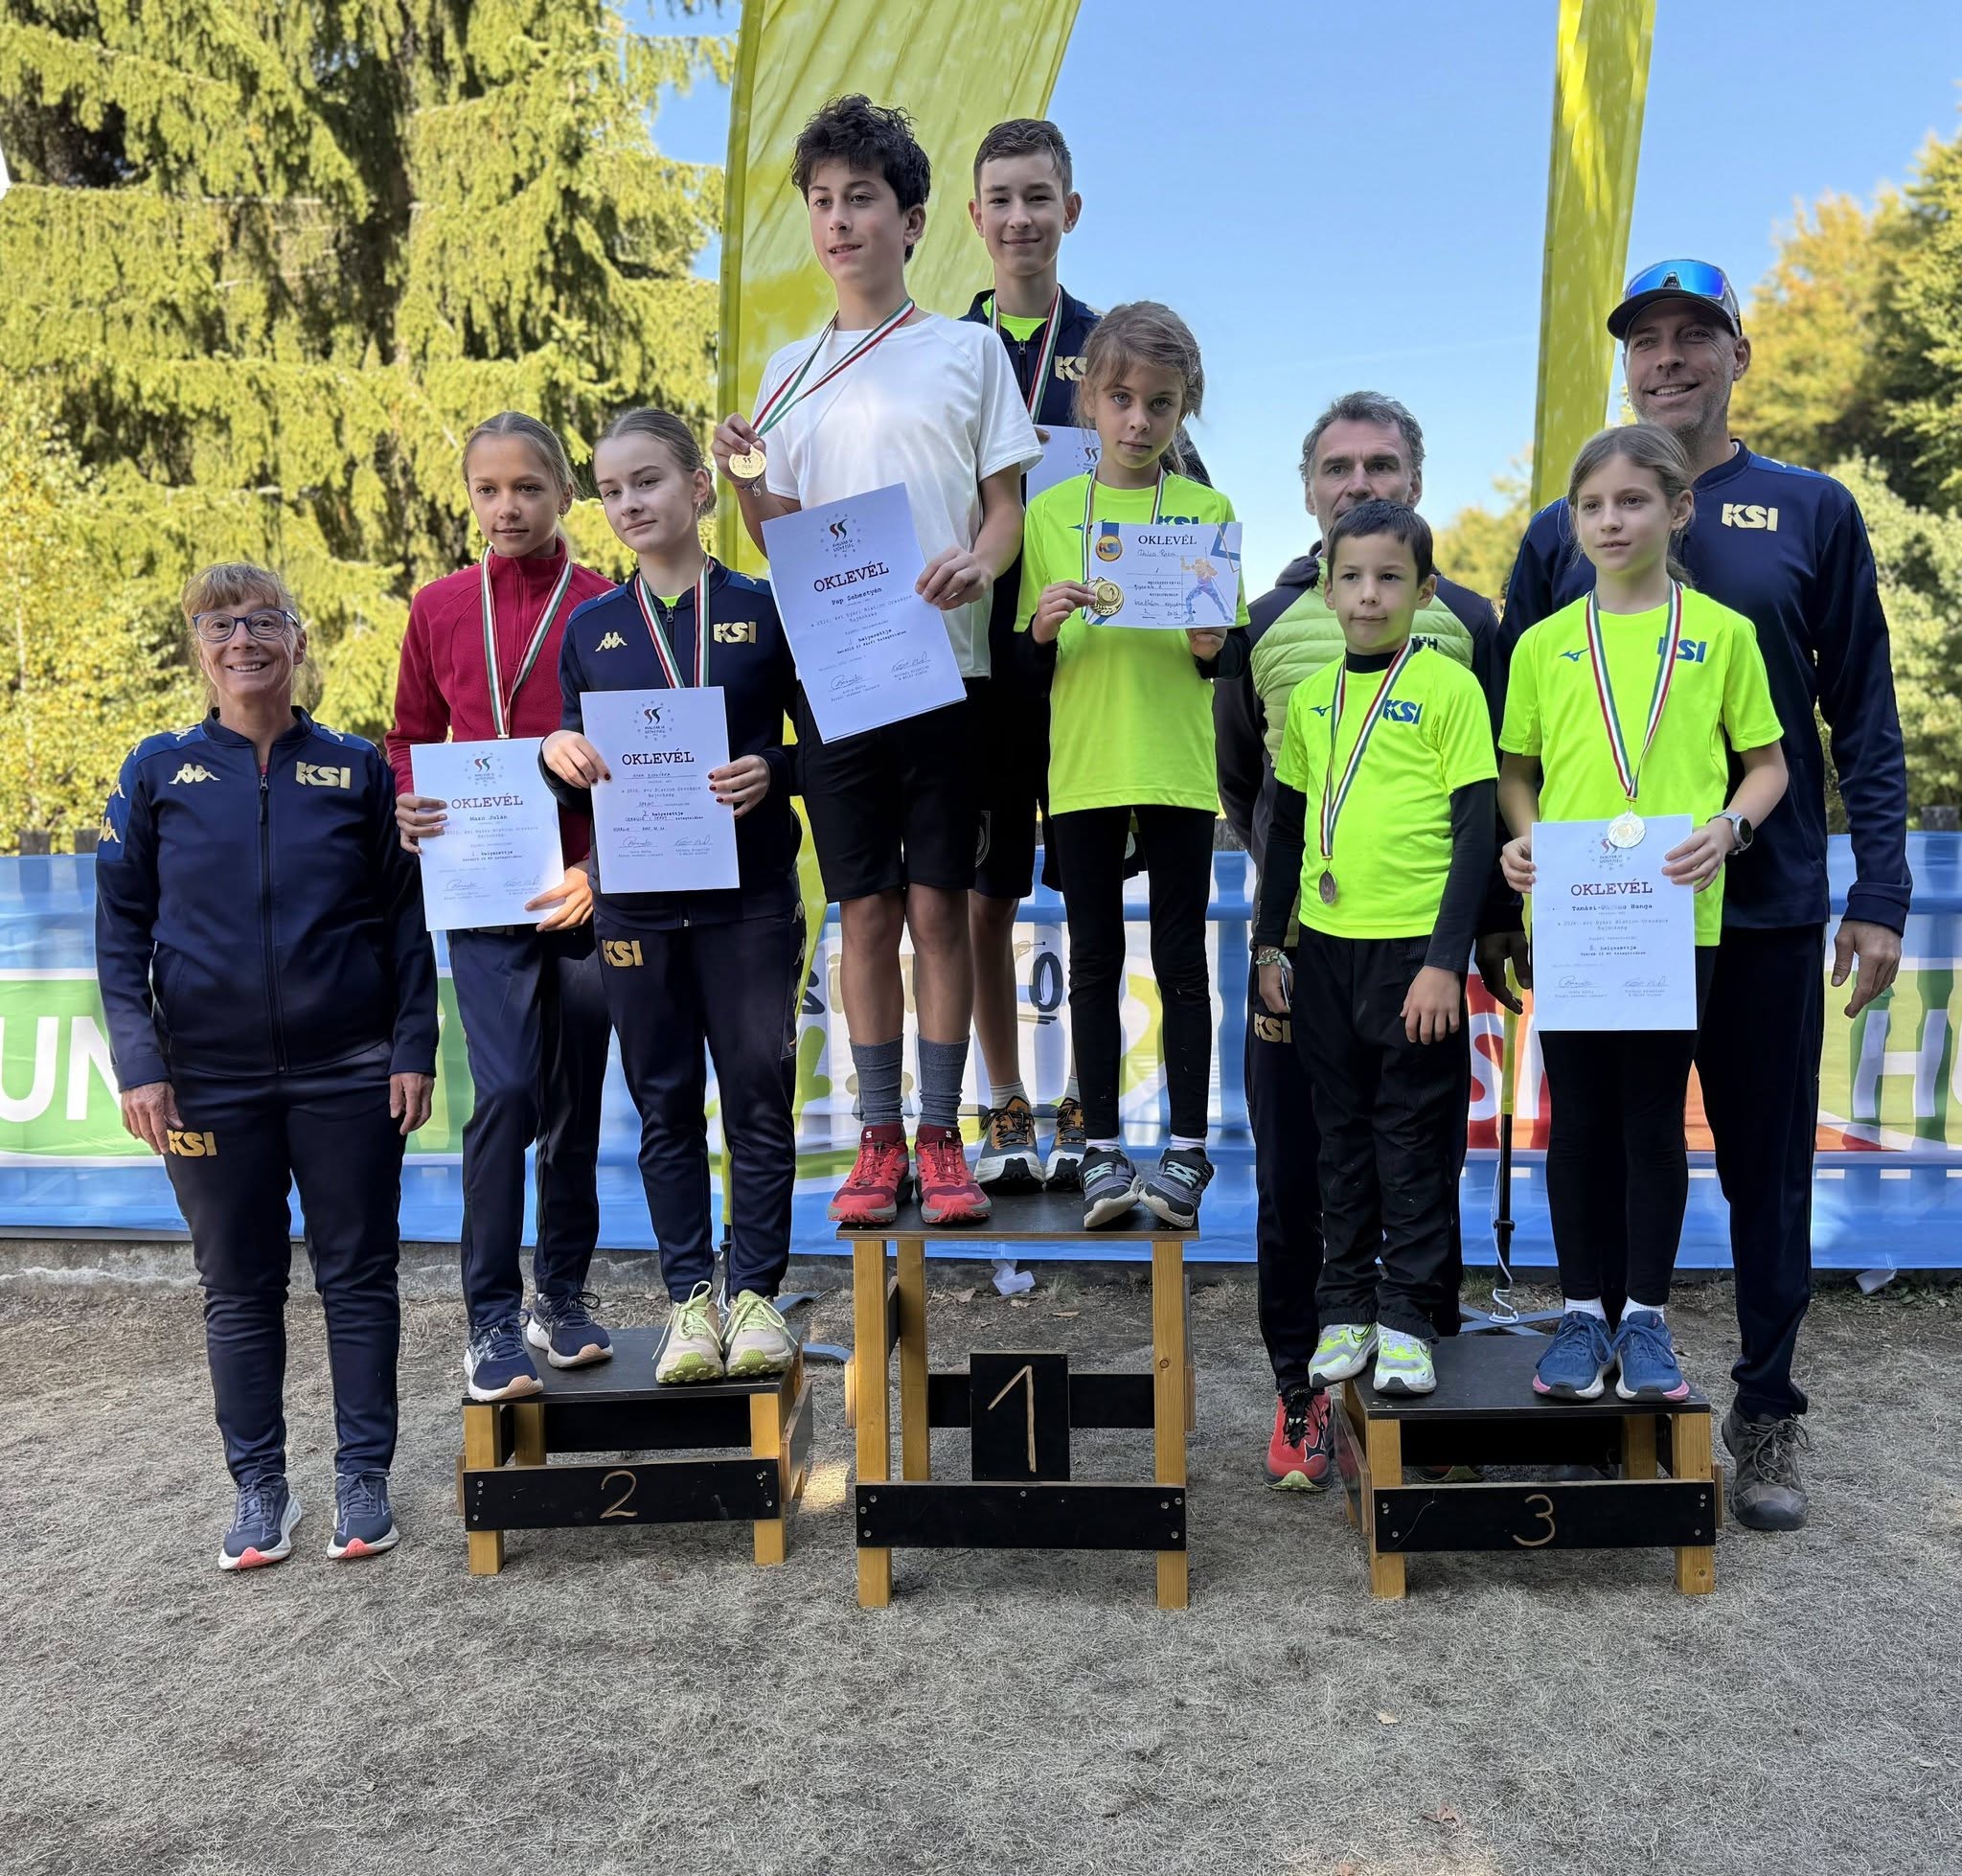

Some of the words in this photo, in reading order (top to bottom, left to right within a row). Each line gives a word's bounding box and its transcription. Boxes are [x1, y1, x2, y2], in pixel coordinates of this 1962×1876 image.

[1721, 503, 1779, 532] KSI
[1138, 534, 1198, 545] OKLEVÉL
[813, 561, 889, 593] OKLEVÉL
[713, 622, 757, 644] KSI
[1382, 699, 1423, 724] KSI
[622, 748, 695, 766] OKLEVÉL
[295, 762, 352, 789] KSI
[451, 792, 524, 810] OKLEVÉL
[1571, 878, 1654, 896] OKLEVÉL
[601, 939, 645, 967] KSI
[1254, 1012, 1291, 1043] KSI
[166, 1129, 217, 1156] KSI
[988, 1364, 1037, 1473] 1
[600, 1470, 638, 1518] 2
[1512, 1494, 1556, 1547] 3
